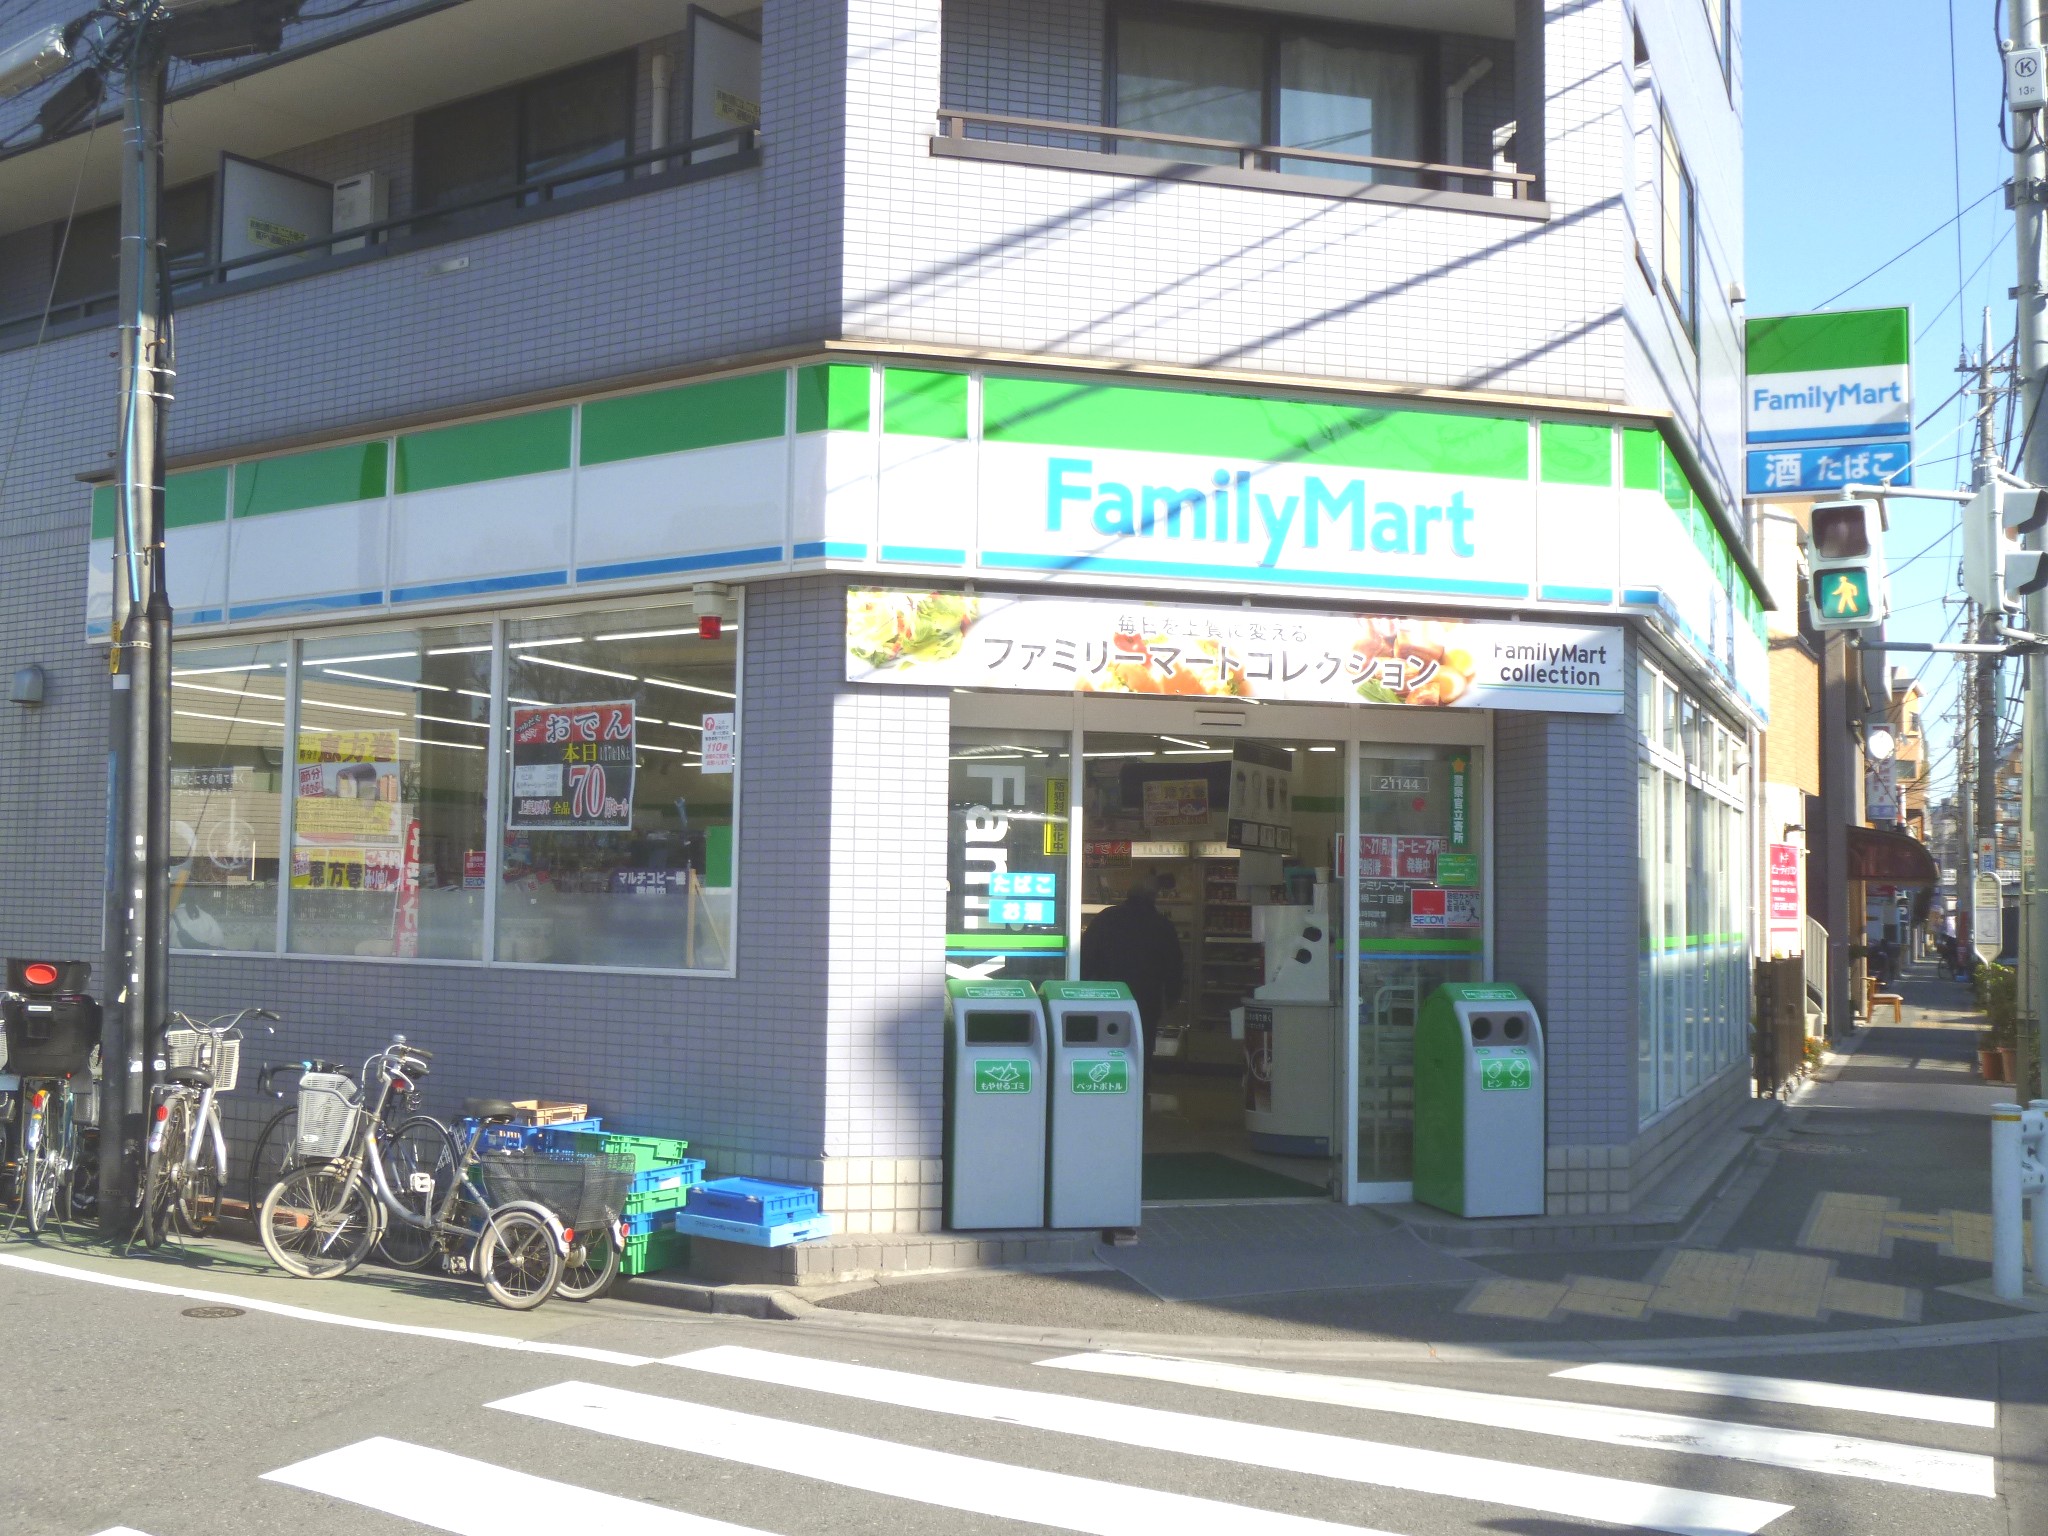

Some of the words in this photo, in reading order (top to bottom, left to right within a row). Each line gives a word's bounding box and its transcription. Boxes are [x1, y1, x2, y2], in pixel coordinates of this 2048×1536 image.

[1754, 381, 1900, 413] FamilyMart
[1765, 453, 1802, 488] 酒
[1818, 451, 1895, 480] たばこ
[1045, 457, 1475, 568] FamilyMart
[983, 636, 1440, 690] ファミリーマートコレクション
[1494, 640, 1607, 666] FamilyMart
[1500, 664, 1600, 687] collection
[545, 709, 631, 743] おでん
[562, 743, 598, 763] 本日
[568, 763, 606, 818] 70
[993, 875, 1052, 894] たばこ
[1358, 881, 1411, 893] ァミリーマート
[1359, 894, 1404, 905] 根二丁目店
[1002, 902, 1043, 921] お酒
[1413, 916, 1444, 925] SECOM
[981, 1081, 1025, 1091] もやせるゴミ
[1077, 1082, 1123, 1091] ペットボトル
